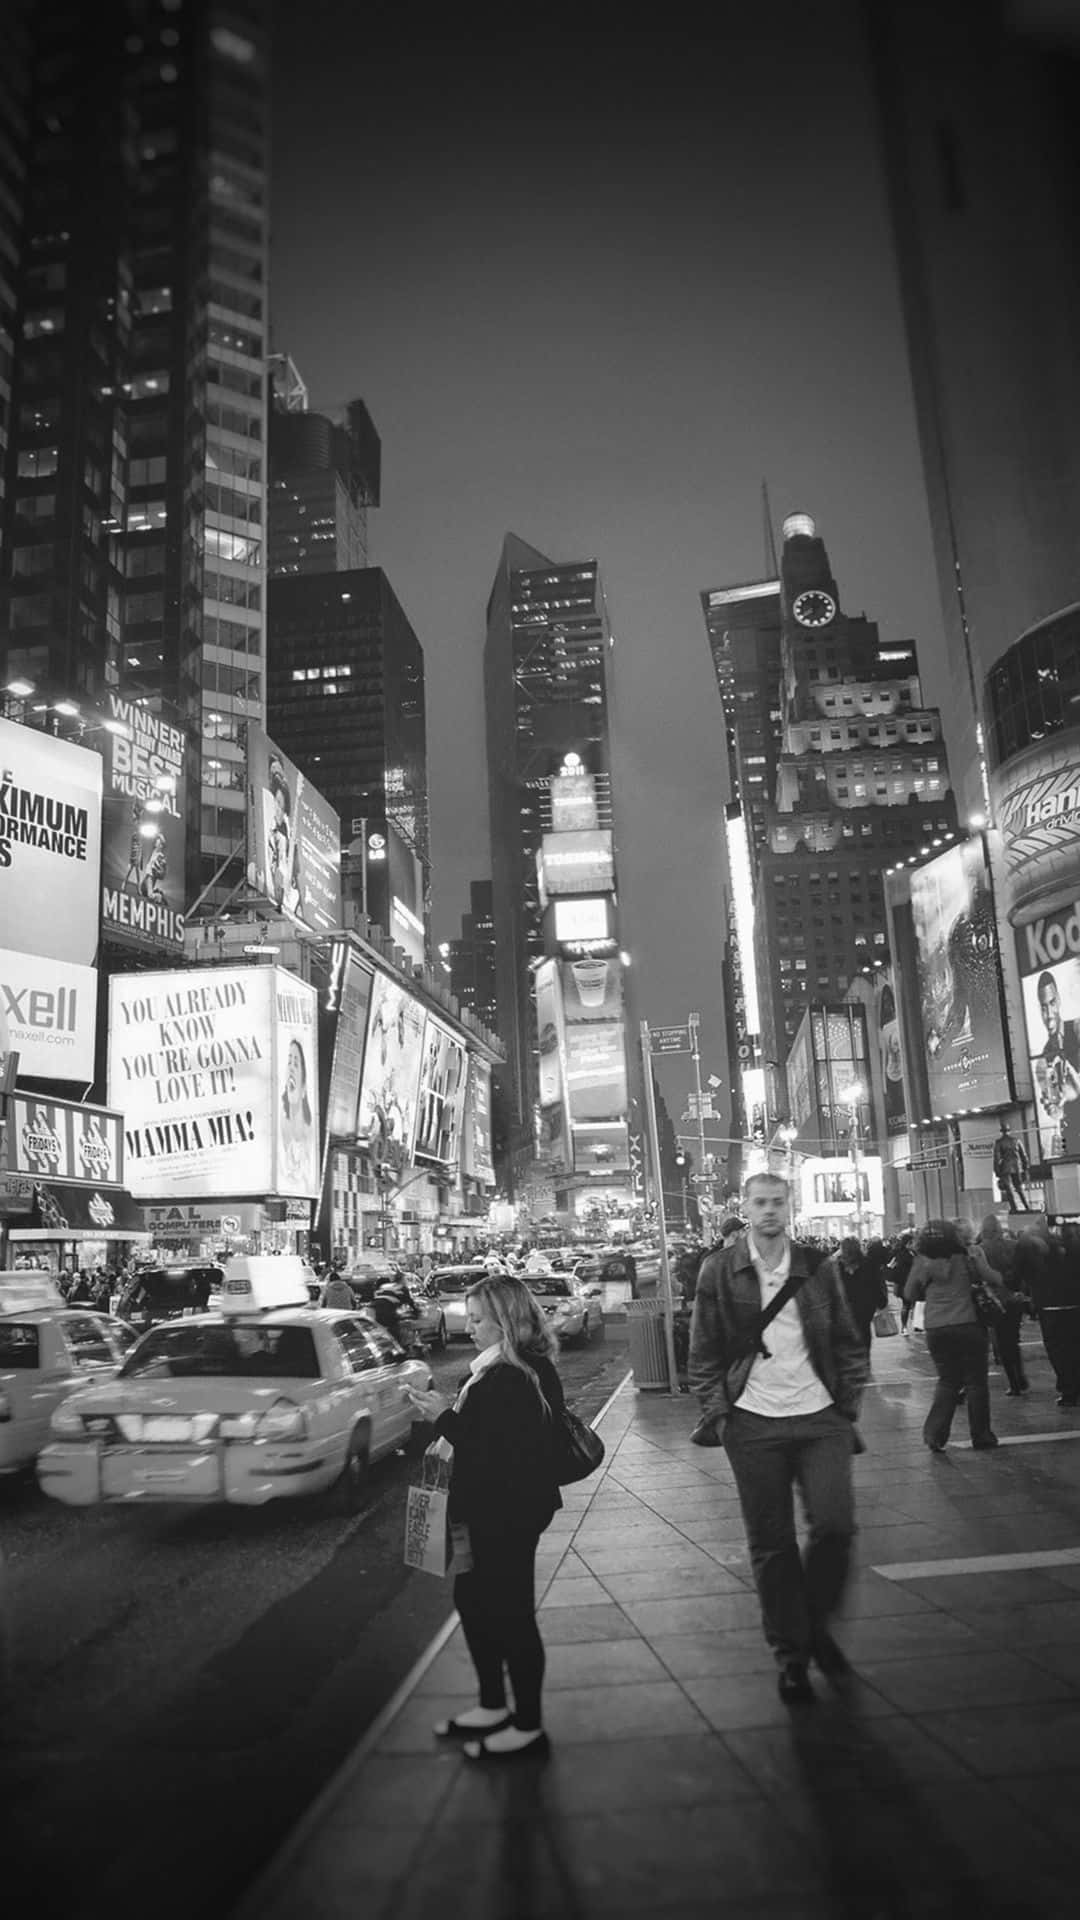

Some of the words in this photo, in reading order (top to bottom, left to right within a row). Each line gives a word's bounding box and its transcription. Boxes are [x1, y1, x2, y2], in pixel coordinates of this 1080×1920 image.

[109, 693, 186, 753] WINNER!
[111, 733, 182, 797] BEST
[559, 764, 585, 777] 2011
[111, 773, 182, 819] MUSICAL
[1026, 785, 1080, 828] Han
[103, 886, 185, 943] MEMPHIS
[120, 997, 155, 1025] YOU
[164, 981, 249, 1019] ALREADY
[159, 1014, 216, 1047] KNOW
[121, 1047, 192, 1080] YOU'RE
[196, 1035, 263, 1069] GONNA
[155, 1073, 206, 1104] LOVE
[209, 1066, 237, 1096] IT!
[126, 1119, 203, 1160] MAMMA
[207, 1110, 255, 1147] MIA!
[148, 1219, 222, 1231] COMPUTERS
[150, 1206, 201, 1221] TAL
